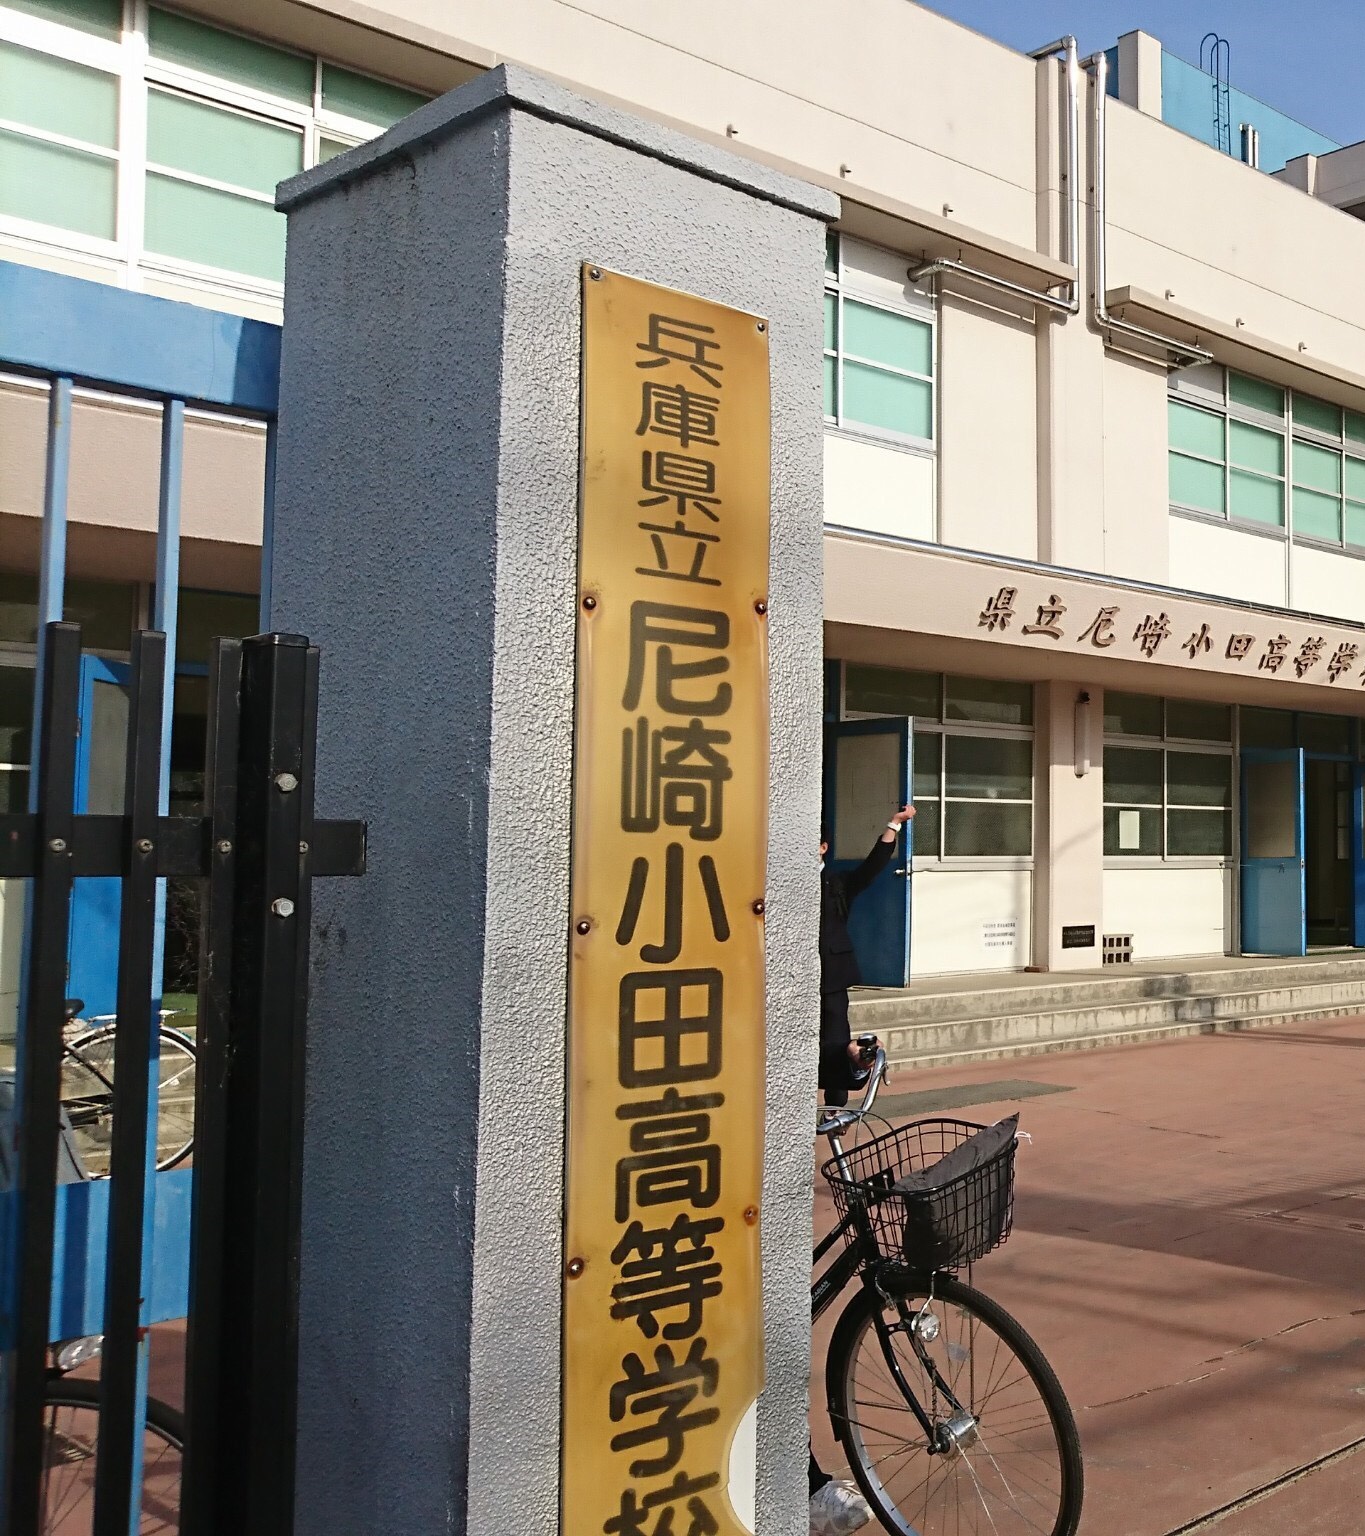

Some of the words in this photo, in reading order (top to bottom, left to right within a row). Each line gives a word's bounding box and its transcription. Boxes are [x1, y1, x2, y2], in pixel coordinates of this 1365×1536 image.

[603, 313, 731, 1536] 兵庫県立尼崎小田高等学校
